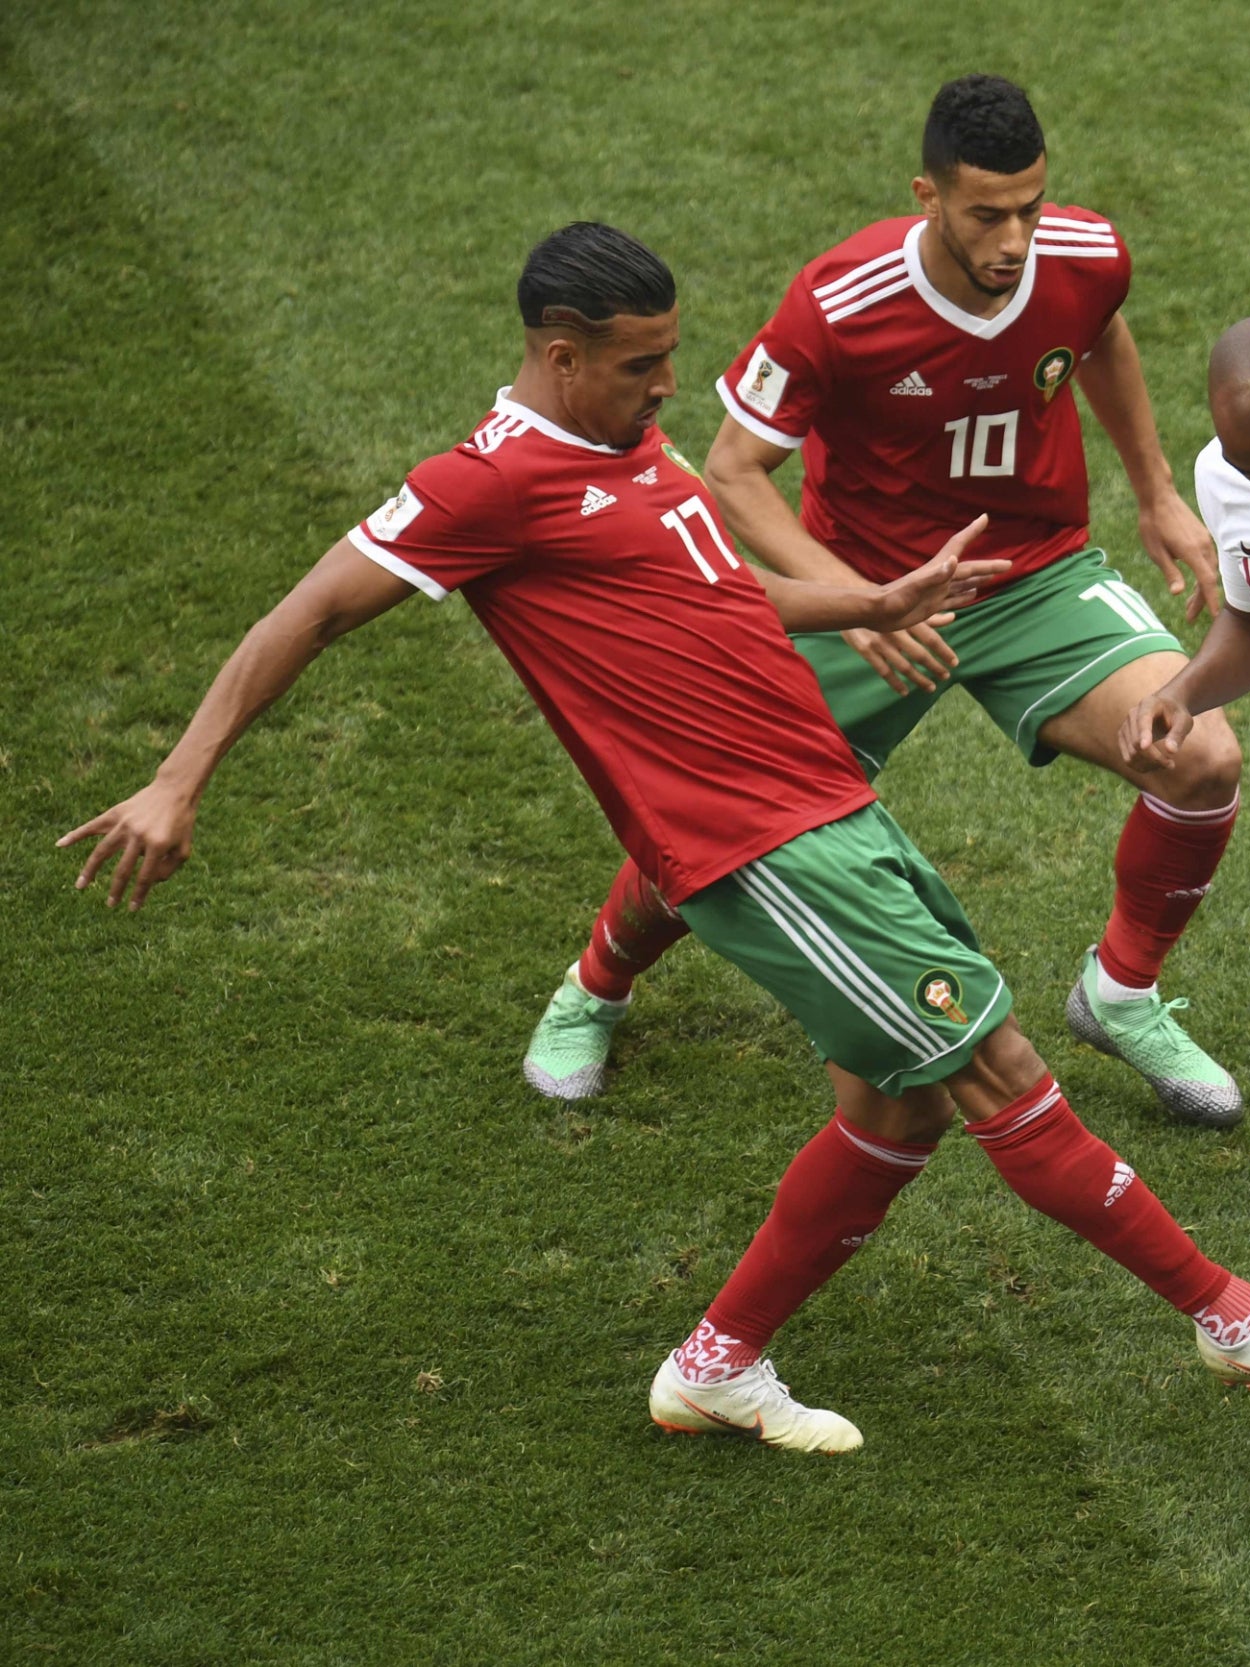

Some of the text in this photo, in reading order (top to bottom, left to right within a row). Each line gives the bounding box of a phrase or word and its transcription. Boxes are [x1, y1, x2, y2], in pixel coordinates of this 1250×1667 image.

[890, 384, 933, 397] adidas
[944, 409, 1020, 478] 10
[580, 494, 618, 516] adidas
[660, 494, 740, 585] 17
